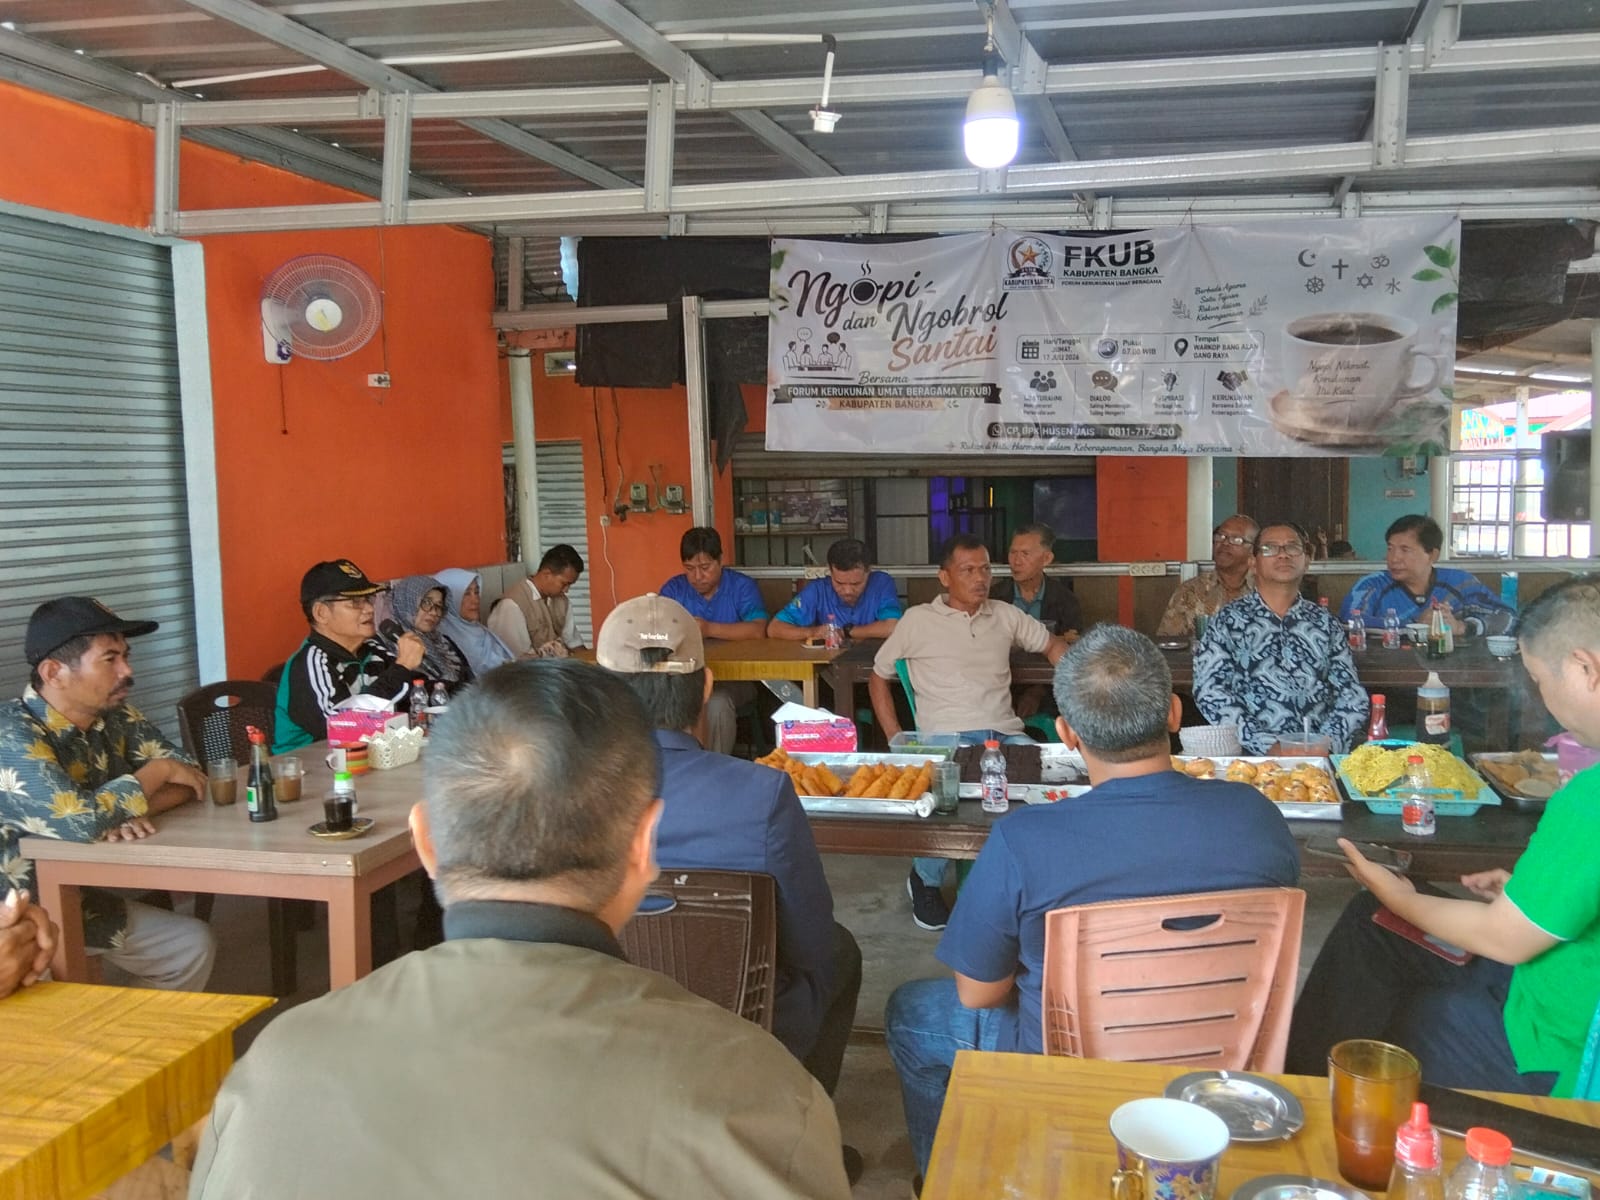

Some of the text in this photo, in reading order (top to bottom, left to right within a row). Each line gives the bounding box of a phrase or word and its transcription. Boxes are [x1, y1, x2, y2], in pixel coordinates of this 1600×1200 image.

[1064, 240, 1155, 268] FKUB
[1063, 266, 1159, 278] KABUPATEN BANGKA
[788, 270, 921, 329] Ngopi
[842, 292, 1009, 343] dan Ngobrol
[1194, 335, 1220, 343] Tempat
[888, 325, 998, 372] Santai
[858, 371, 911, 385] Bersama
[788, 386, 993, 397] FORUM KERUKUNAN UMAT BERAGAMA (FKUB)
[839, 400, 934, 409] KABUPATEN BANGKA
[1042, 427, 1073, 436] HUSEN
[1074, 427, 1095, 436] JAIS
